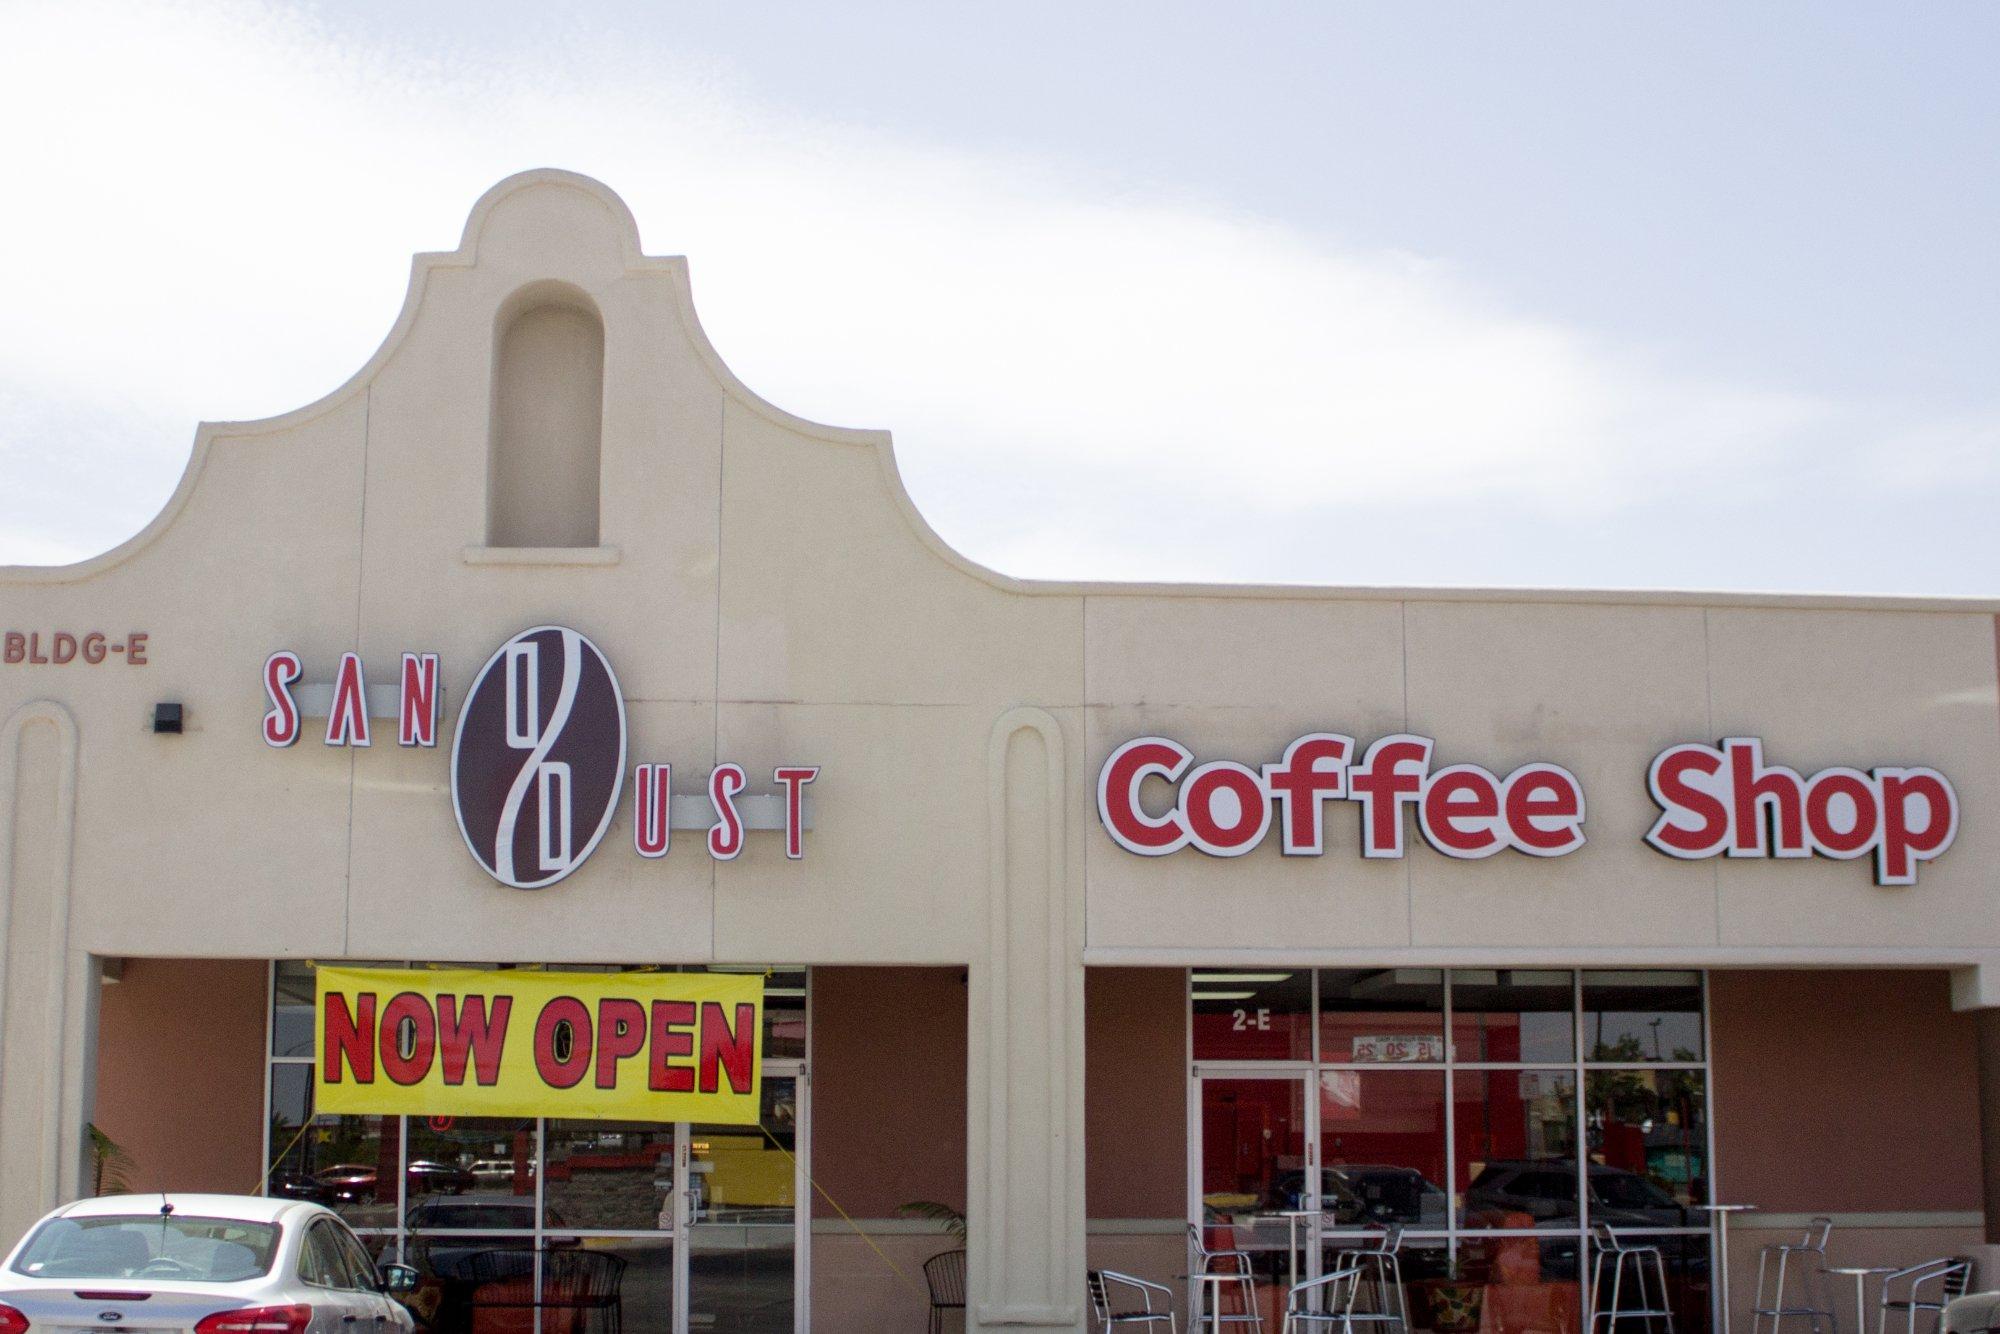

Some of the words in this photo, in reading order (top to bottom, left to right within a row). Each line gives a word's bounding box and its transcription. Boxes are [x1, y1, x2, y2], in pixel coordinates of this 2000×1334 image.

[4, 631, 148, 665] BLDG-E
[1097, 733, 1588, 859] Coffee
[1642, 737, 1961, 886] Shop
[323, 991, 513, 1086] NOW
[533, 995, 756, 1095] OPEN
[1232, 1008, 1271, 1031] 2-E
